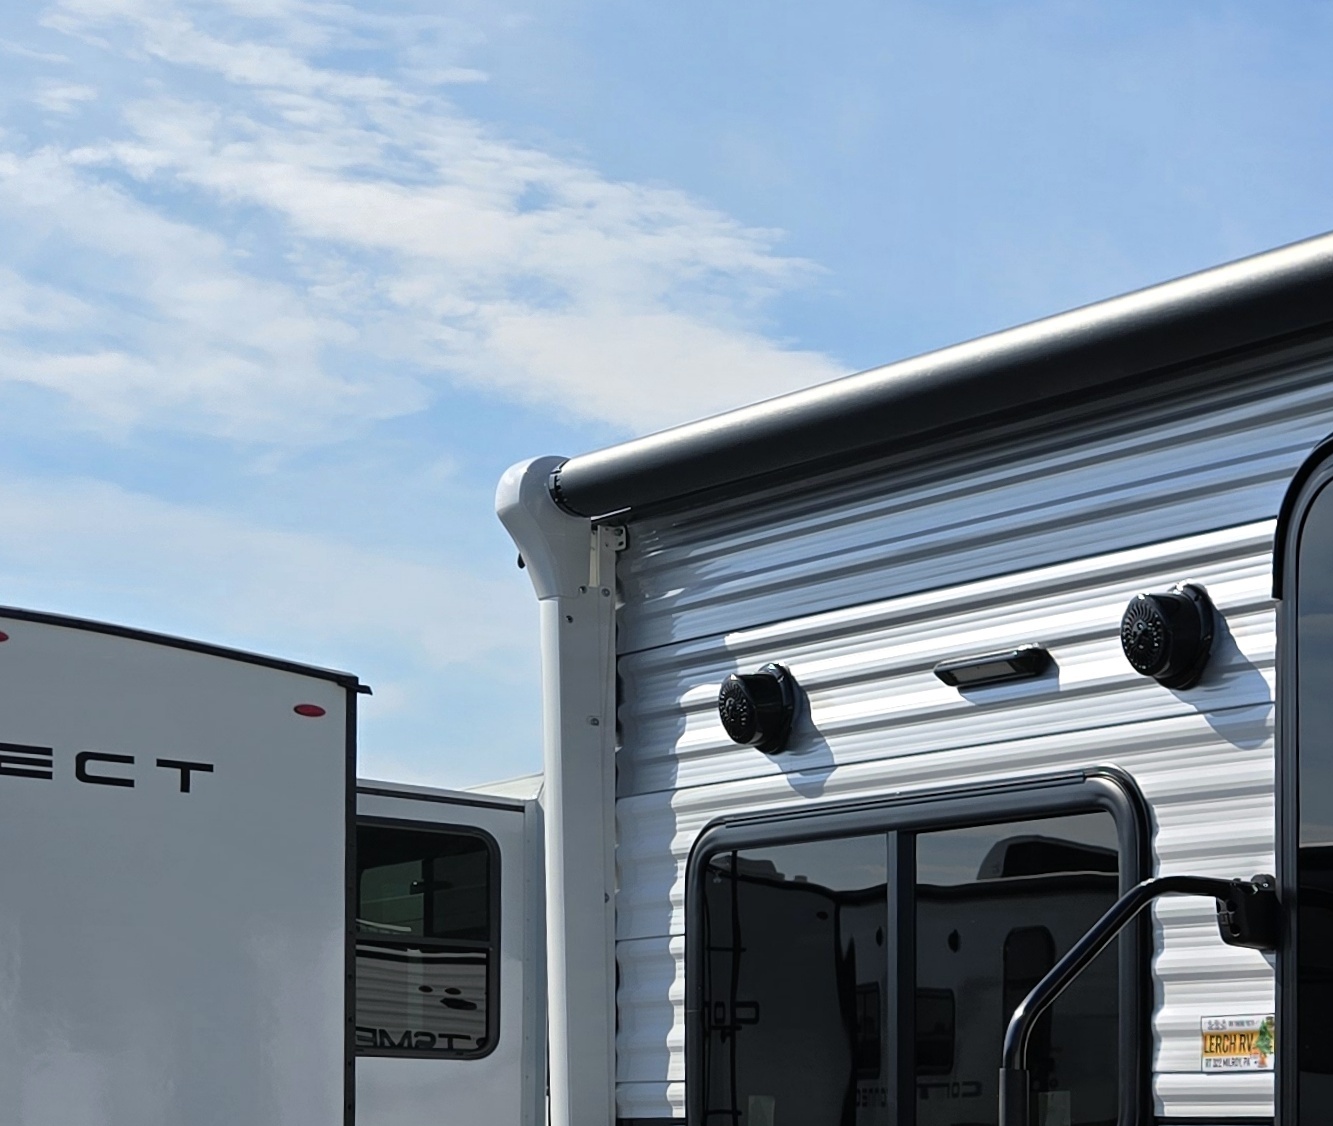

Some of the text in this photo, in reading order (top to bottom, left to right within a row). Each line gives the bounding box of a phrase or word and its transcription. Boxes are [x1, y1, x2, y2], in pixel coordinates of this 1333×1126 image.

[0, 743, 214, 793] ECT
[1204, 1033, 1254, 1054] LERCH RV
